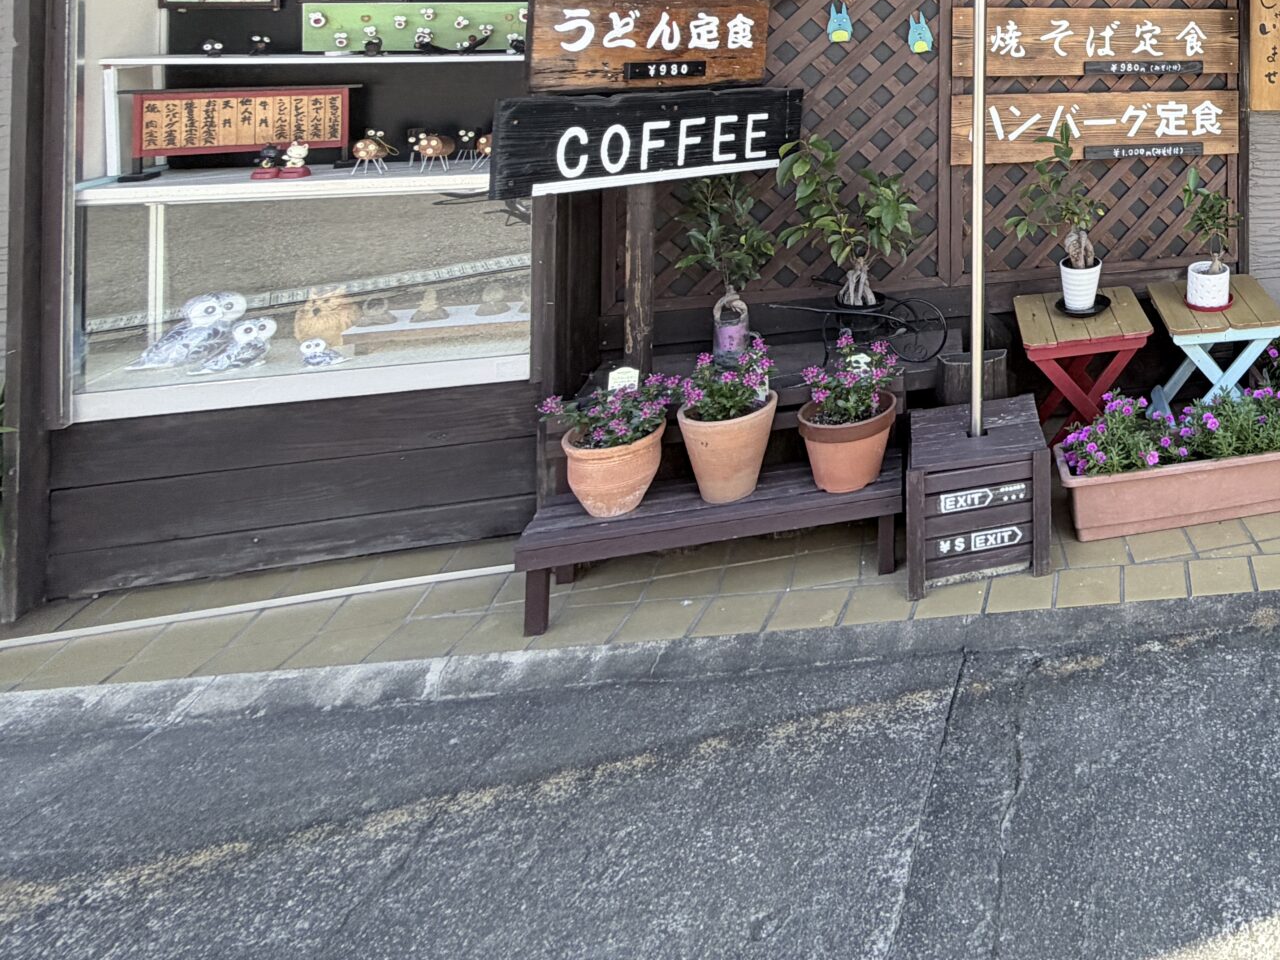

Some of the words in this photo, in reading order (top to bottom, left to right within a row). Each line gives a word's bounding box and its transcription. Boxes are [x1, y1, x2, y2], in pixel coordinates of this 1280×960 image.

[553, 8, 755, 53] うどん定食
[990, 19, 1208, 58] 焼そば定食
[648, 63, 690, 77] ¥980
[556, 113, 769, 179] COFFEE
[945, 493, 983, 510] EXIT
[975, 530, 1013, 548] EXIT
